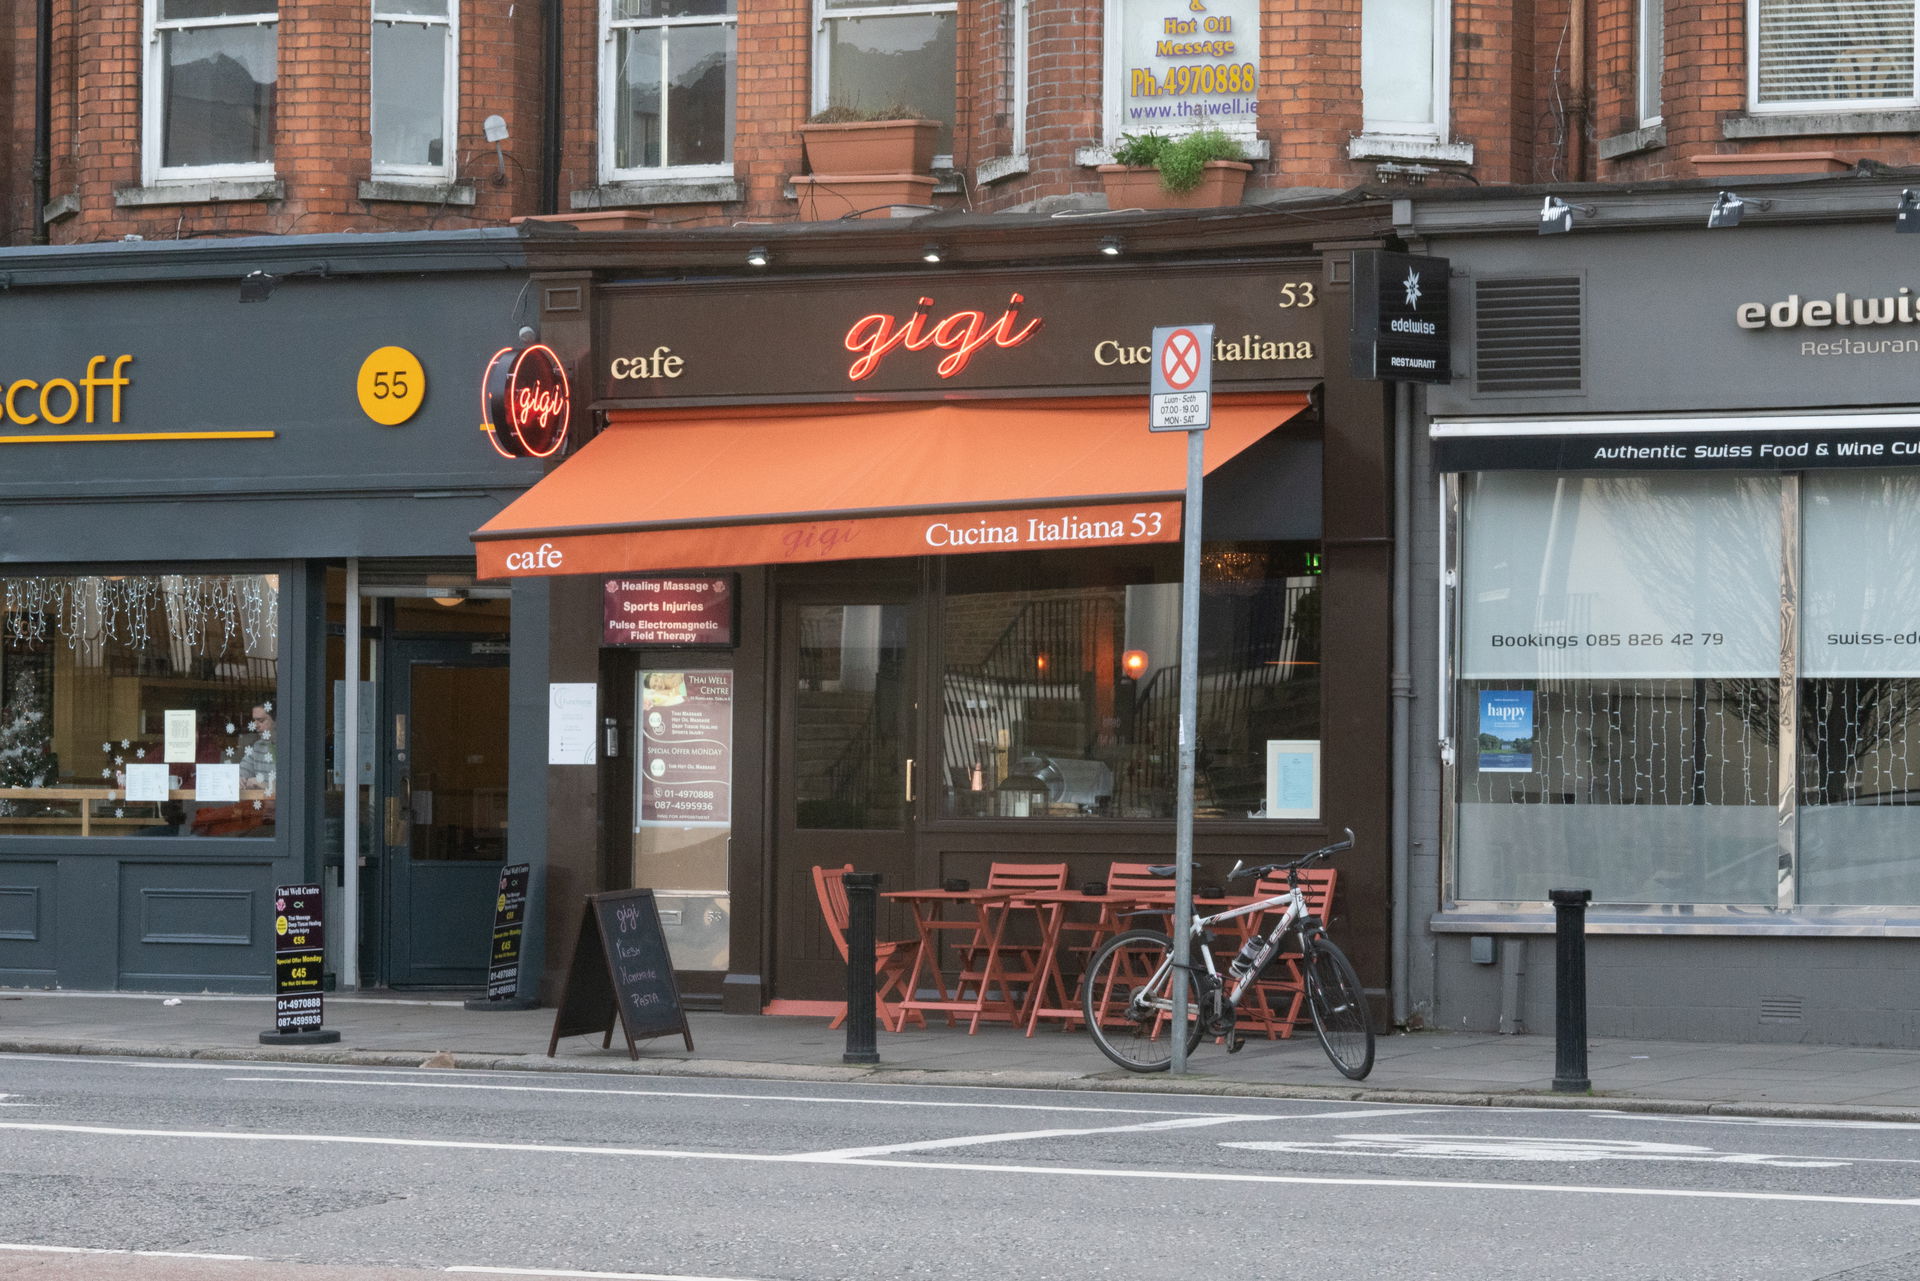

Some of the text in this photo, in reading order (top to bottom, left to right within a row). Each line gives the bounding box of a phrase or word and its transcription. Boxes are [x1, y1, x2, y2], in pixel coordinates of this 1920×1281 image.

[1163, 16, 1231, 34] Hot Oil
[1156, 40, 1235, 57] Message
[1130, 63, 1255, 97] Ph.4970888
[1130, 98, 1257, 119] www.thaiwell.ie
[1279, 282, 1315, 308] 53
[1737, 287, 1920, 329] edelwi
[1391, 318, 1436, 335] edelwise
[845, 292, 1043, 382] gigi
[1212, 334, 1314, 362] taliana
[610, 346, 685, 380] cafe
[0, 354, 133, 425] coff
[373, 371, 408, 399] 55
[519, 379, 564, 429] gigi
[1160, 405, 1179, 415] 07.00
[1164, 416, 1180, 425] MON
[1183, 415, 1195, 424] SAT
[1594, 445, 1687, 459] Authentic
[1694, 444, 1753, 458] Swiss
[1760, 442, 1809, 457] Food
[1815, 443, 1829, 456] &
[1837, 442, 1884, 456] Wine
[925, 511, 1163, 547] Cucina Italiana 53
[783, 520, 862, 558] gigi
[506, 543, 563, 571] cafe
[622, 581, 709, 592] Healing Massage
[623, 601, 704, 613] Sports Injuries
[609, 620, 719, 631] Pulse Electromagnetic
[630, 631, 697, 642] Field Therapy
[1492, 633, 1724, 649] Bookings 085 826 42 79
[1827, 631, 1920, 645] swiss-ed
[688, 675, 727, 685] THAI WELL
[700, 686, 729, 695] CENTRE
[1487, 702, 1527, 721] happy
[664, 789, 714, 799] 01-4970888
[654, 801, 713, 811] 087-4595936
[278, 887, 319, 896] Thai Well Centre
[616, 904, 639, 932] gigi
[292, 968, 307, 978] €45
[278, 998, 321, 1010] 01-4970888
[278, 1015, 321, 1027] 087-4595936
